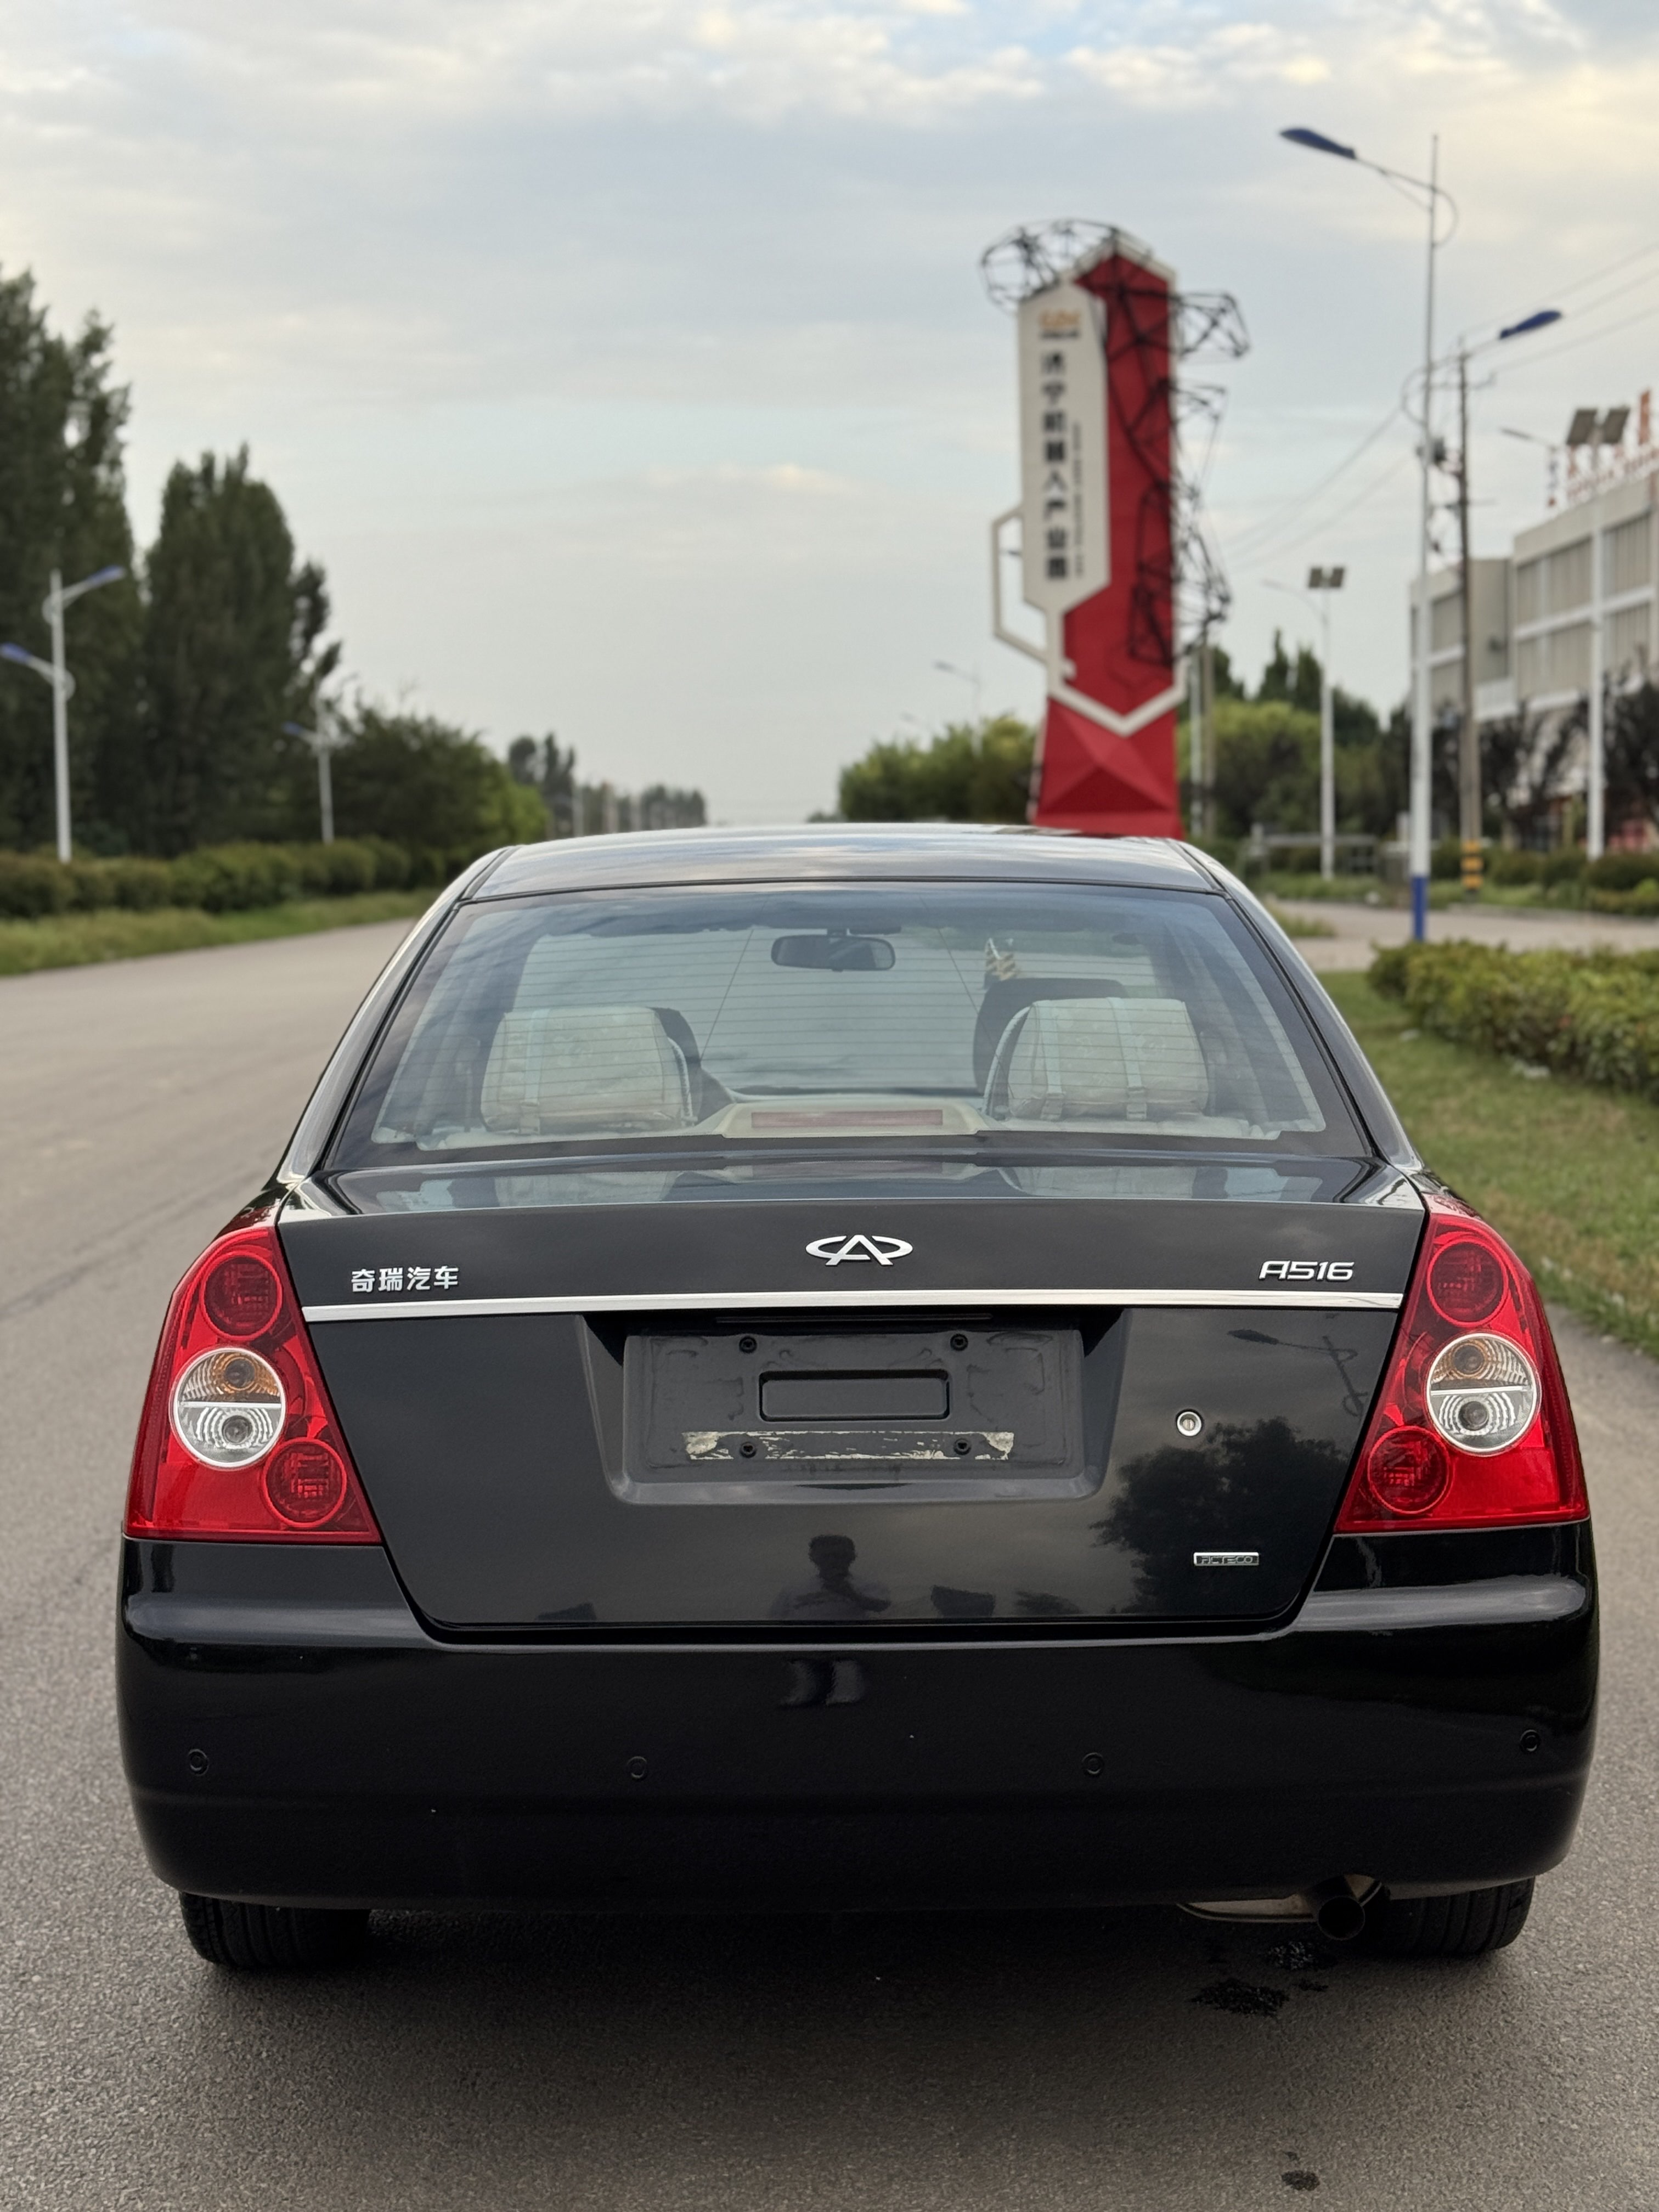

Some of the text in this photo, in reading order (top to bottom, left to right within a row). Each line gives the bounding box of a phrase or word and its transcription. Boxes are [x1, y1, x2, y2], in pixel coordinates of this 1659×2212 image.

[351, 1265, 459, 1293] 奇瑞汽车
[1259, 1260, 1355, 1282] A516
